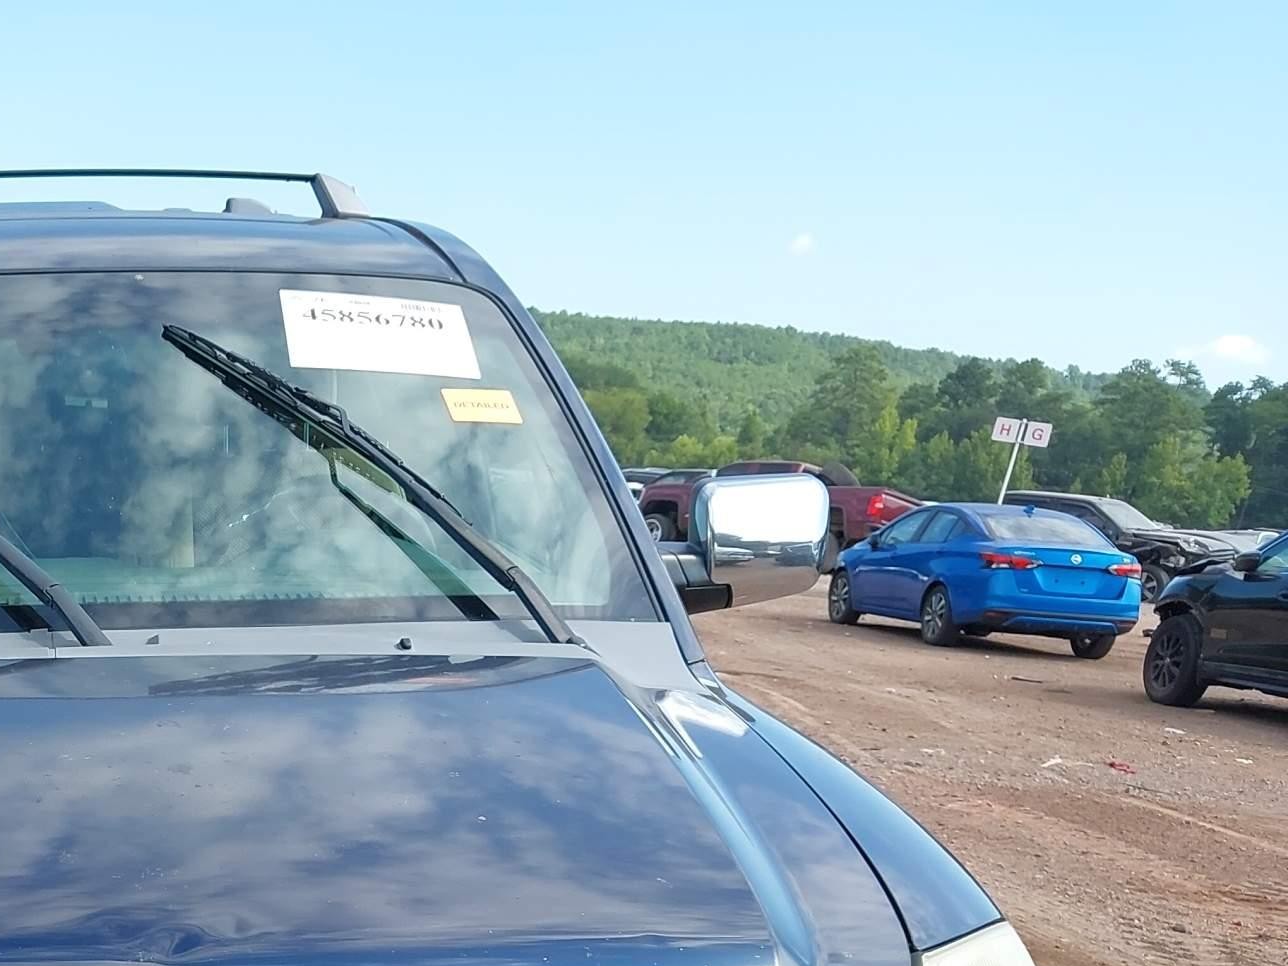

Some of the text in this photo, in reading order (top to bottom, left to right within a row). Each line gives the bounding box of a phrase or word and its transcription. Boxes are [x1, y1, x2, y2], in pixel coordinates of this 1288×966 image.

[303, 307, 444, 330] 45856780
[999, 423, 1012, 436] H
[1031, 428, 1044, 441] G
